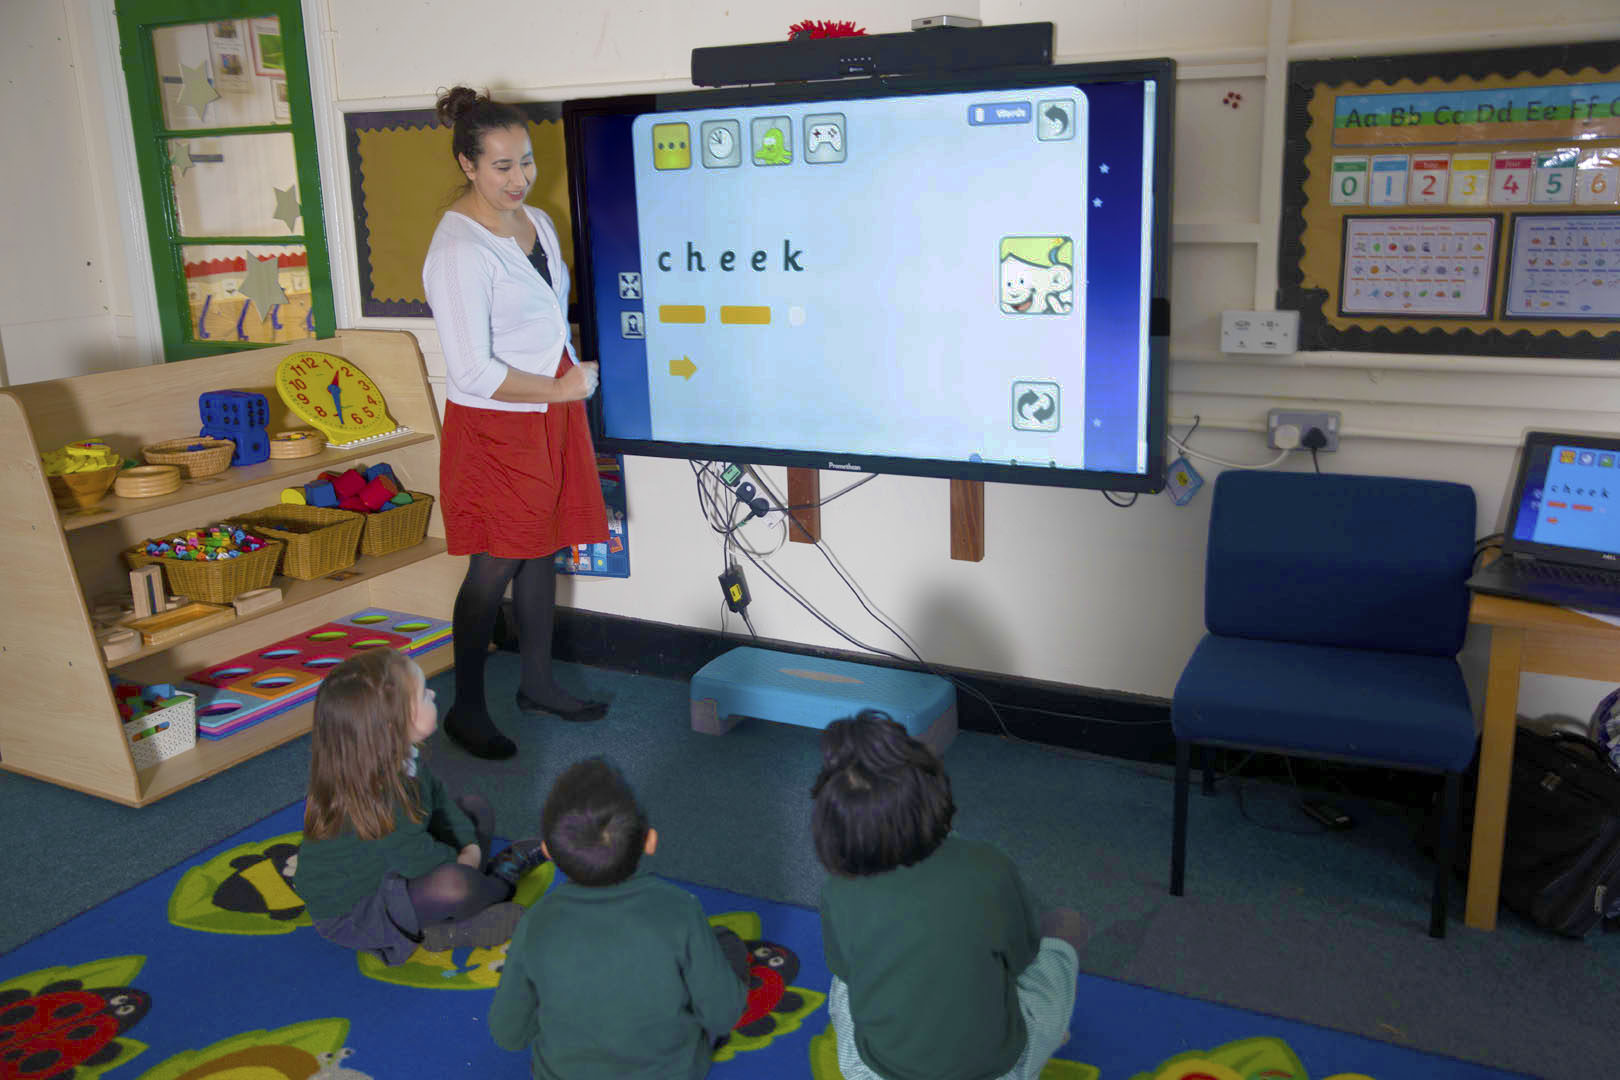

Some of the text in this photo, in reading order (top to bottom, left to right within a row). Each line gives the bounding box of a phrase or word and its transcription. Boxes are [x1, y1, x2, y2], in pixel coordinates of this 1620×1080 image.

[1345, 107, 1377, 128] Aa
[1391, 104, 1421, 127] Bb
[1434, 105, 1464, 125] Cc
[1477, 100, 1513, 123] Dd
[1527, 100, 1558, 121] Ee
[1570, 95, 1600, 126] Ff
[1341, 176, 1357, 197] 0
[1421, 175, 1437, 196] 2
[1463, 175, 1477, 196] 3
[1503, 173, 1519, 195] 4
[1545, 173, 1562, 194] 5
[1591, 173, 1607, 194] 6
[657, 240, 804, 272] cheek
[301, 357, 320, 369] 12
[323, 358, 334, 369] 1
[290, 364, 307, 377] 11
[341, 366, 354, 377] 2
[289, 378, 307, 391] 10
[358, 380, 370, 391] 3
[296, 393, 310, 405] 9
[367, 395, 378, 406] 4
[314, 406, 328, 417] 8
[362, 406, 375, 418] 5
[352, 413, 363, 425] 6
